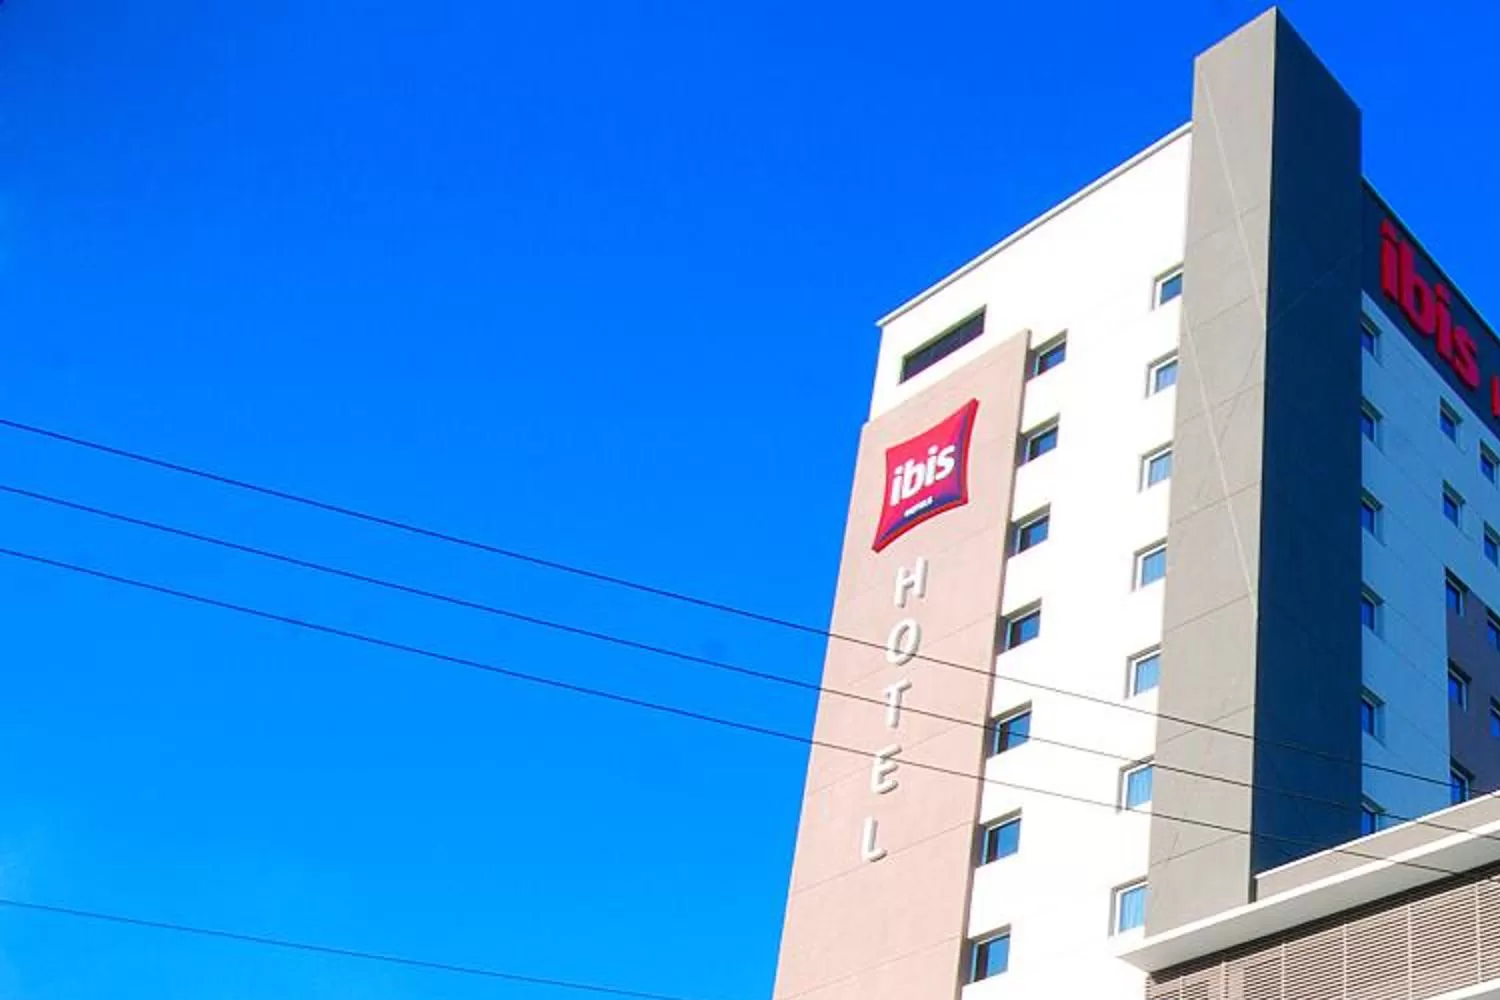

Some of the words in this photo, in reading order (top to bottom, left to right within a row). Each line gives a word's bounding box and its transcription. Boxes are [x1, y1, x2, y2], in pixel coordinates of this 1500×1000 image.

[1379, 217, 1480, 391] ibis
[889, 444, 956, 507] ibis
[861, 556, 929, 863] HOTEL
